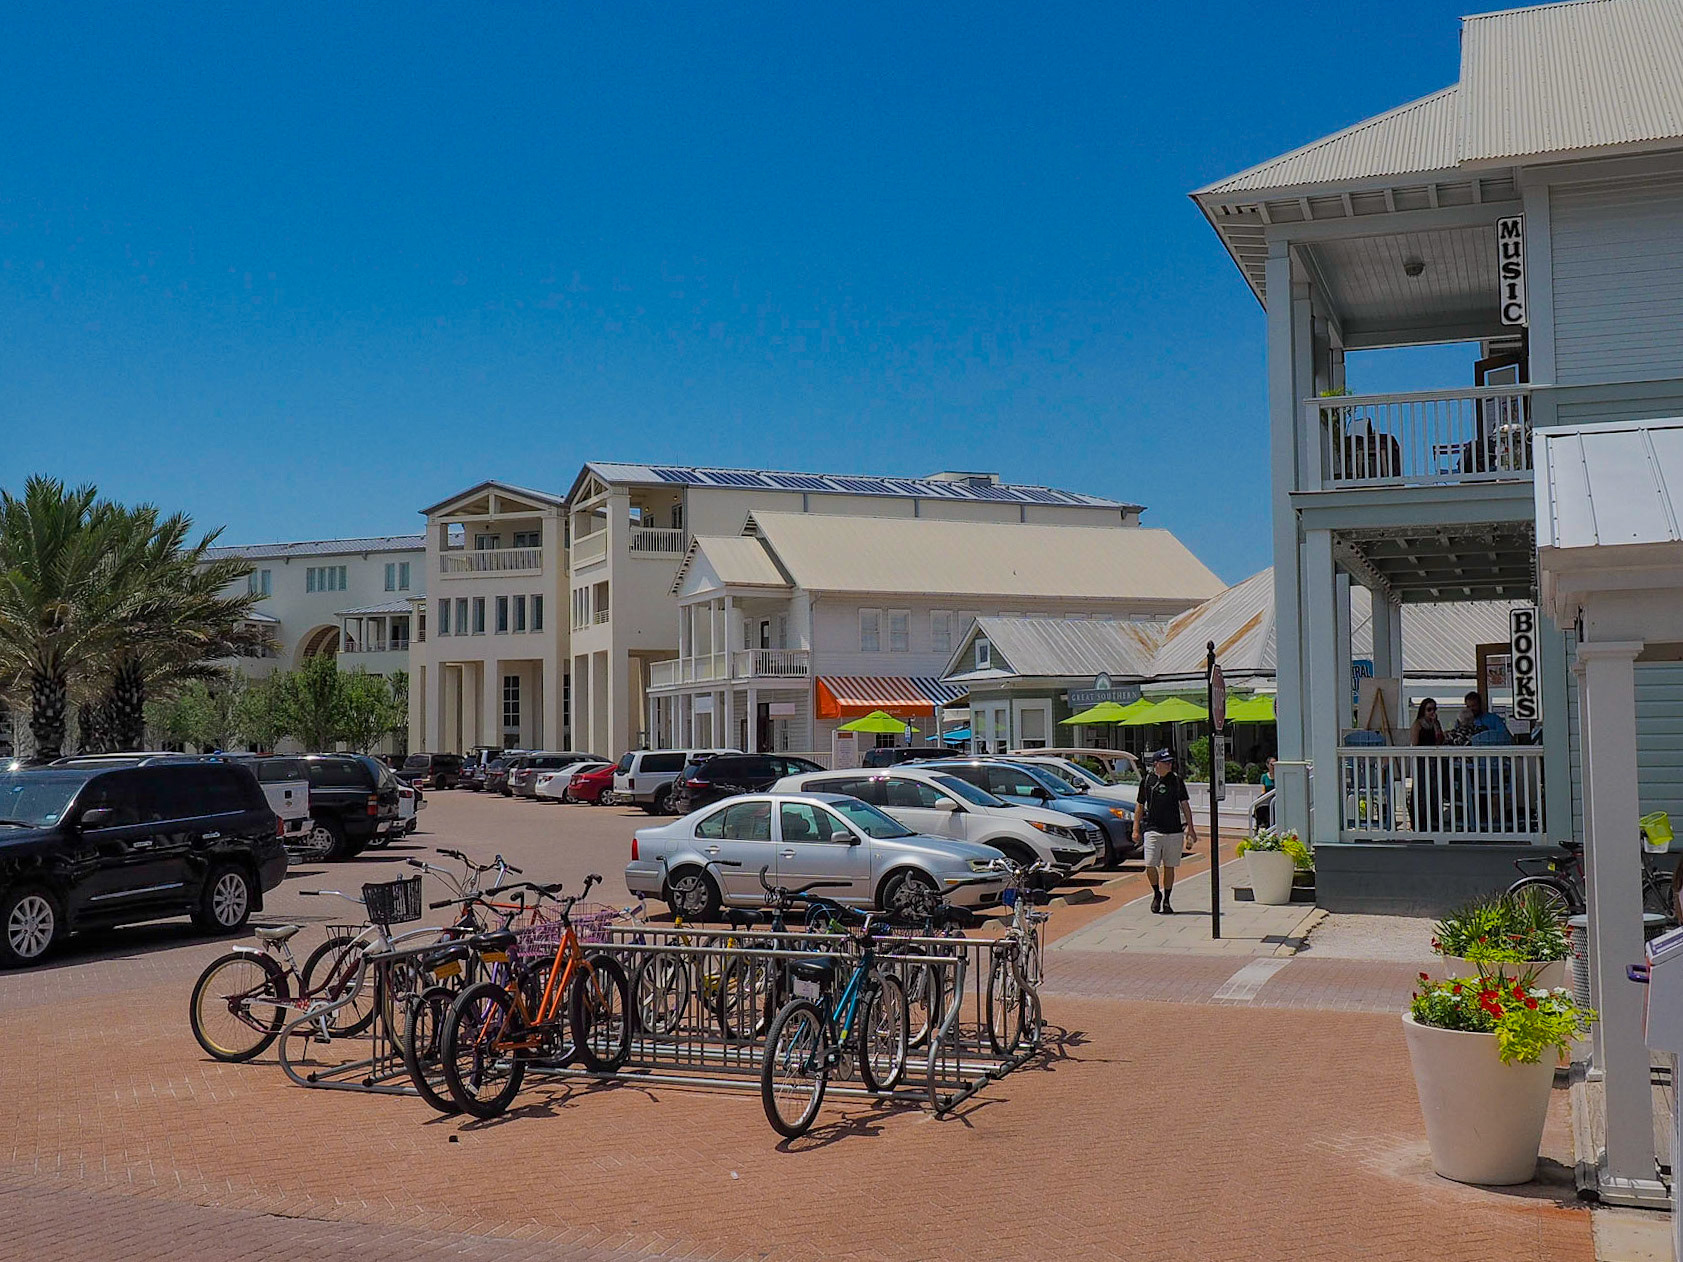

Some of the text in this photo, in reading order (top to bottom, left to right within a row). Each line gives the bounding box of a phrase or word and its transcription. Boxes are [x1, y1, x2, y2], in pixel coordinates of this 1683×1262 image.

[1500, 219, 1523, 322] MUSIC
[1071, 691, 1137, 701] GREAT SOUTHERN
[1513, 611, 1536, 718] BOOKS
